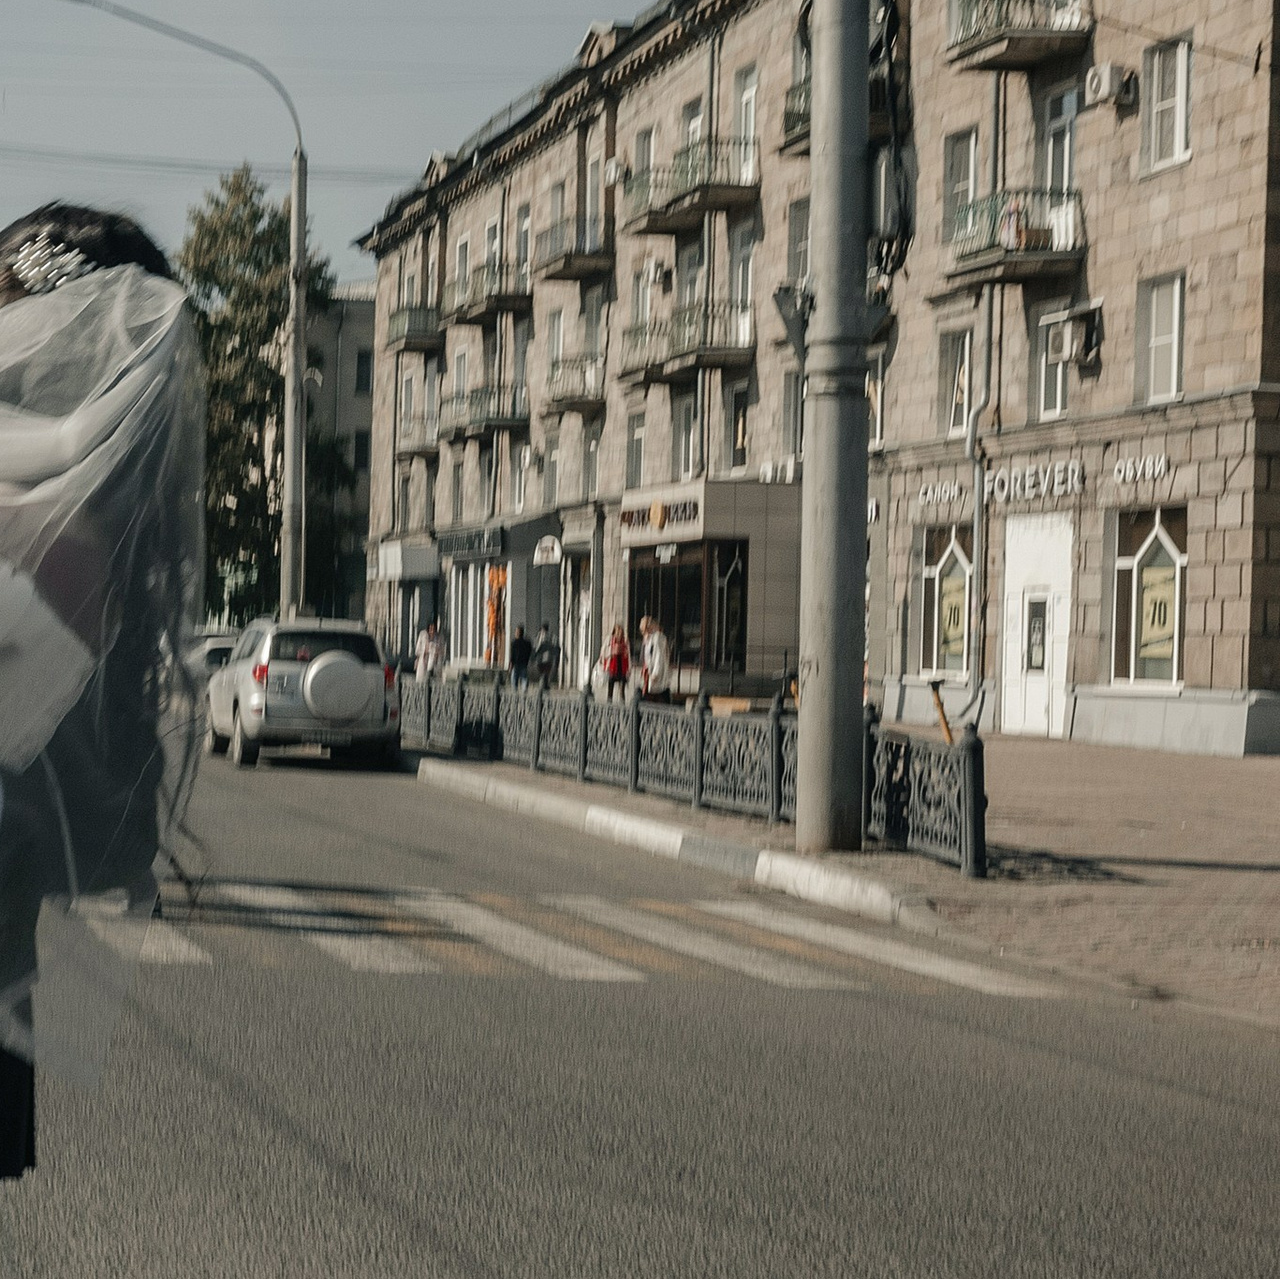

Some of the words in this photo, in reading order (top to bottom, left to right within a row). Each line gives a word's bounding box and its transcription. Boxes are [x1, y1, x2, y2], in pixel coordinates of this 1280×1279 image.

[984, 459, 1083, 504] FOREVER
[1114, 453, 1166, 484] ОБУВИ
[919, 479, 959, 506] САЛОН
